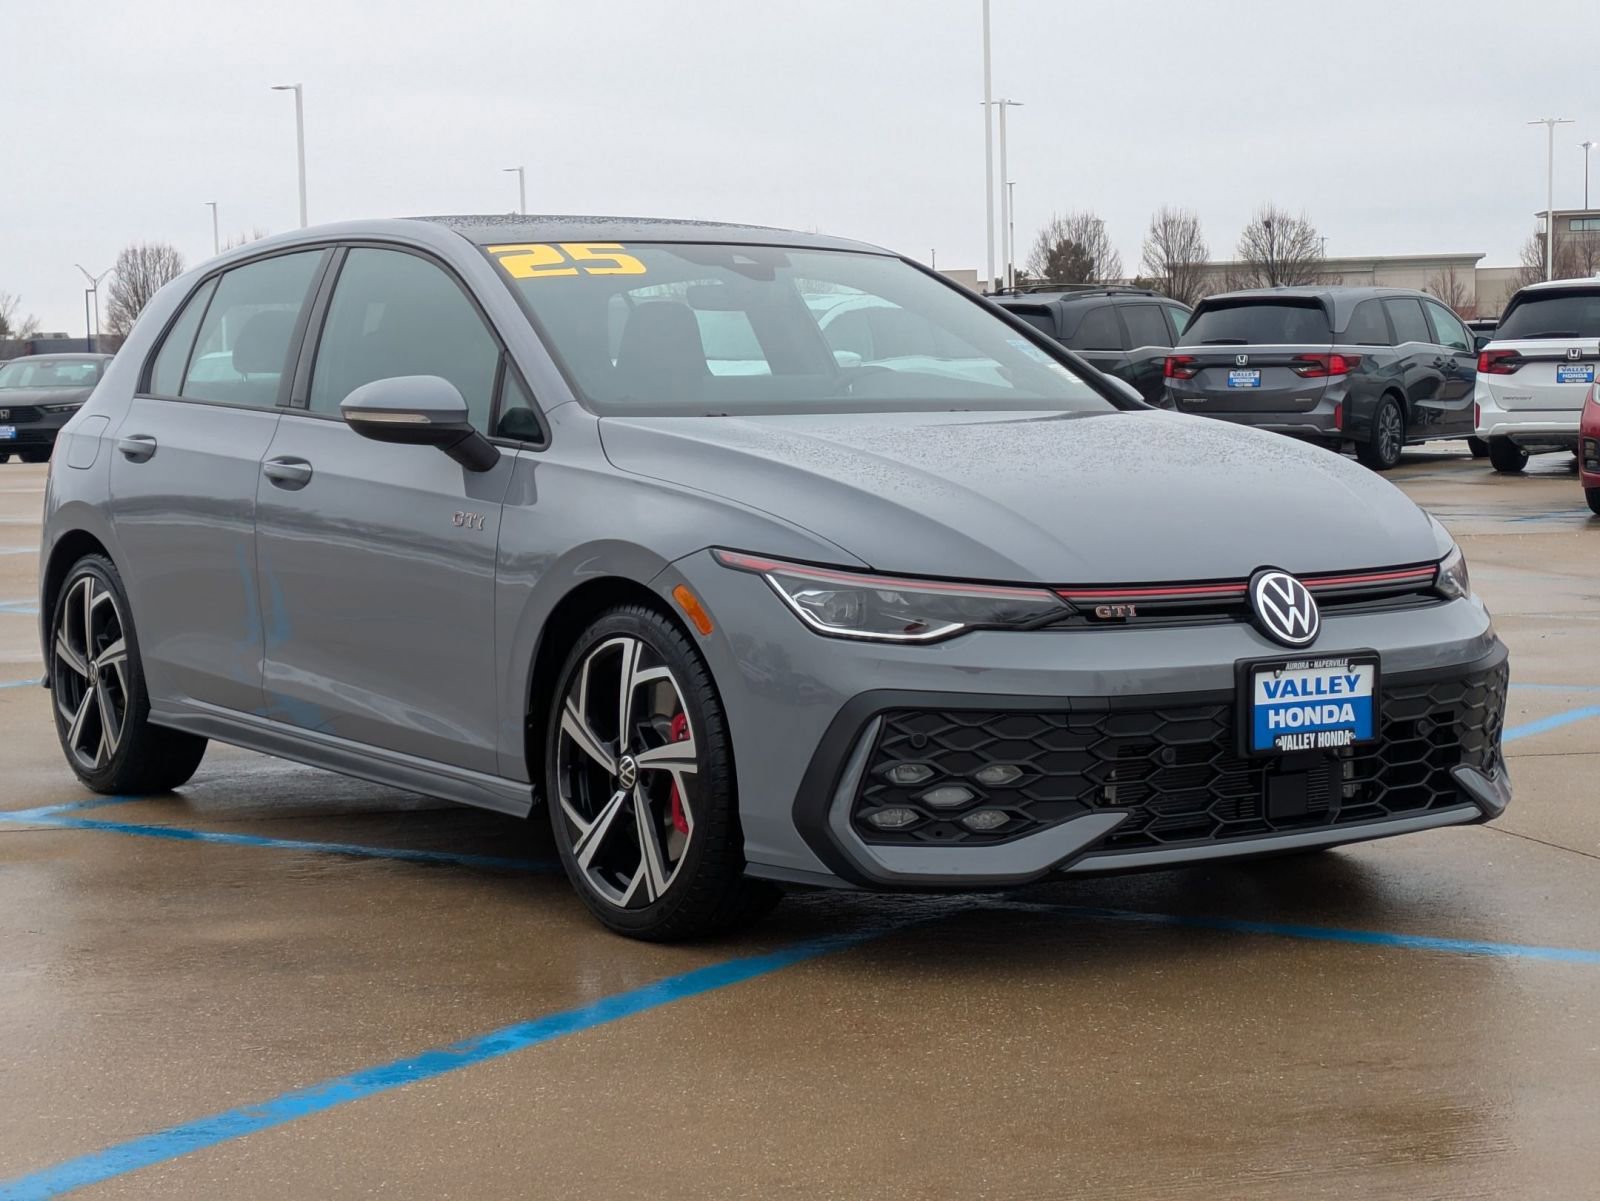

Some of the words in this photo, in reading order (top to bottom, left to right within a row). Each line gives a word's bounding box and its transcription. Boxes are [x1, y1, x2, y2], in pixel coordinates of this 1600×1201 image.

[487, 243, 647, 279] 25
[452, 511, 486, 531] GTI
[1095, 604, 1137, 618] GTI
[1285, 661, 1310, 670] AURORA
[1313, 658, 1349, 668] NAPERVILLE
[1262, 674, 1361, 699] VALLEY
[1268, 703, 1356, 729] HONDA
[1280, 732, 1316, 751] VALLEY
[1317, 729, 1350, 748] HONDA
